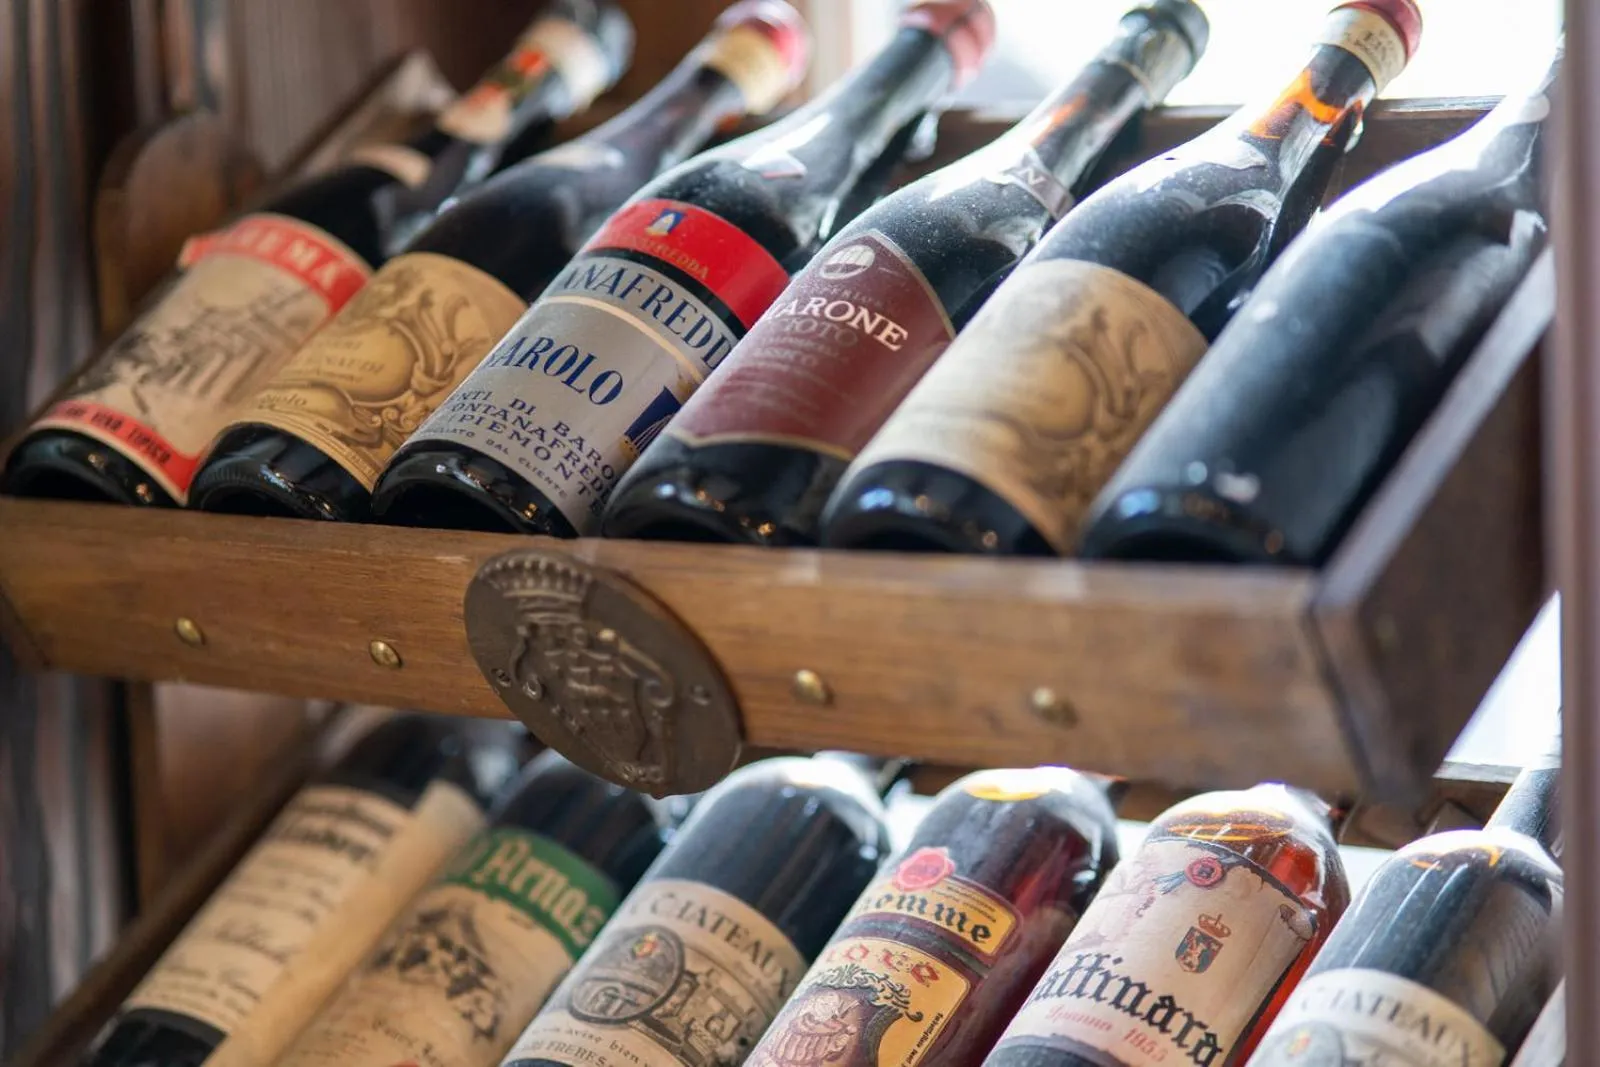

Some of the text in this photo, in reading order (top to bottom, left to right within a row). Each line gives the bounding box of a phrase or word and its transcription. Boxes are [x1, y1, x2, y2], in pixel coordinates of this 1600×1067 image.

[507, 397, 537, 416] DI
[551, 421, 616, 482] BARO
[1029, 952, 1223, 1067] attinara
